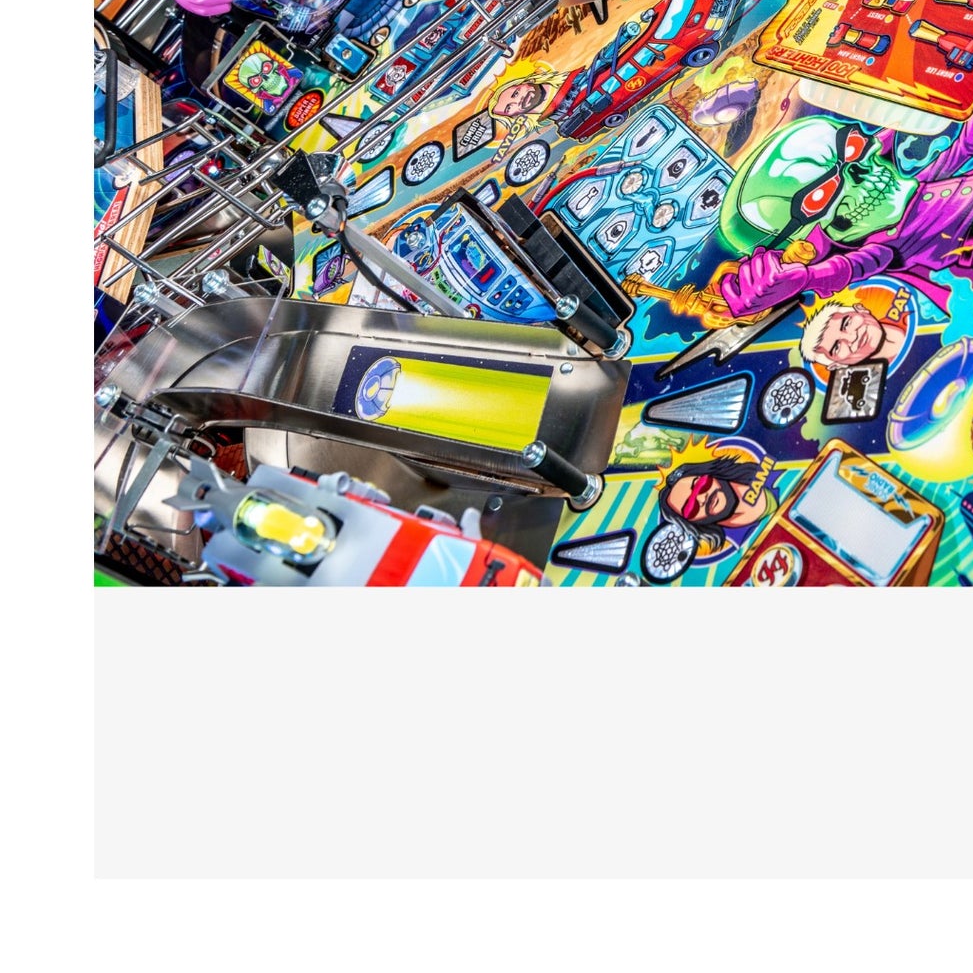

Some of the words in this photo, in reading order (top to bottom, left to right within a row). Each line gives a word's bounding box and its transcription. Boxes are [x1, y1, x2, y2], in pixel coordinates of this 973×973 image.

[765, 46, 832, 72] FIGHTERS
[469, 125, 486, 146] TRON
[492, 115, 527, 163] TAYLOR
[887, 287, 910, 321] PAT
[743, 455, 775, 506] RAMI
